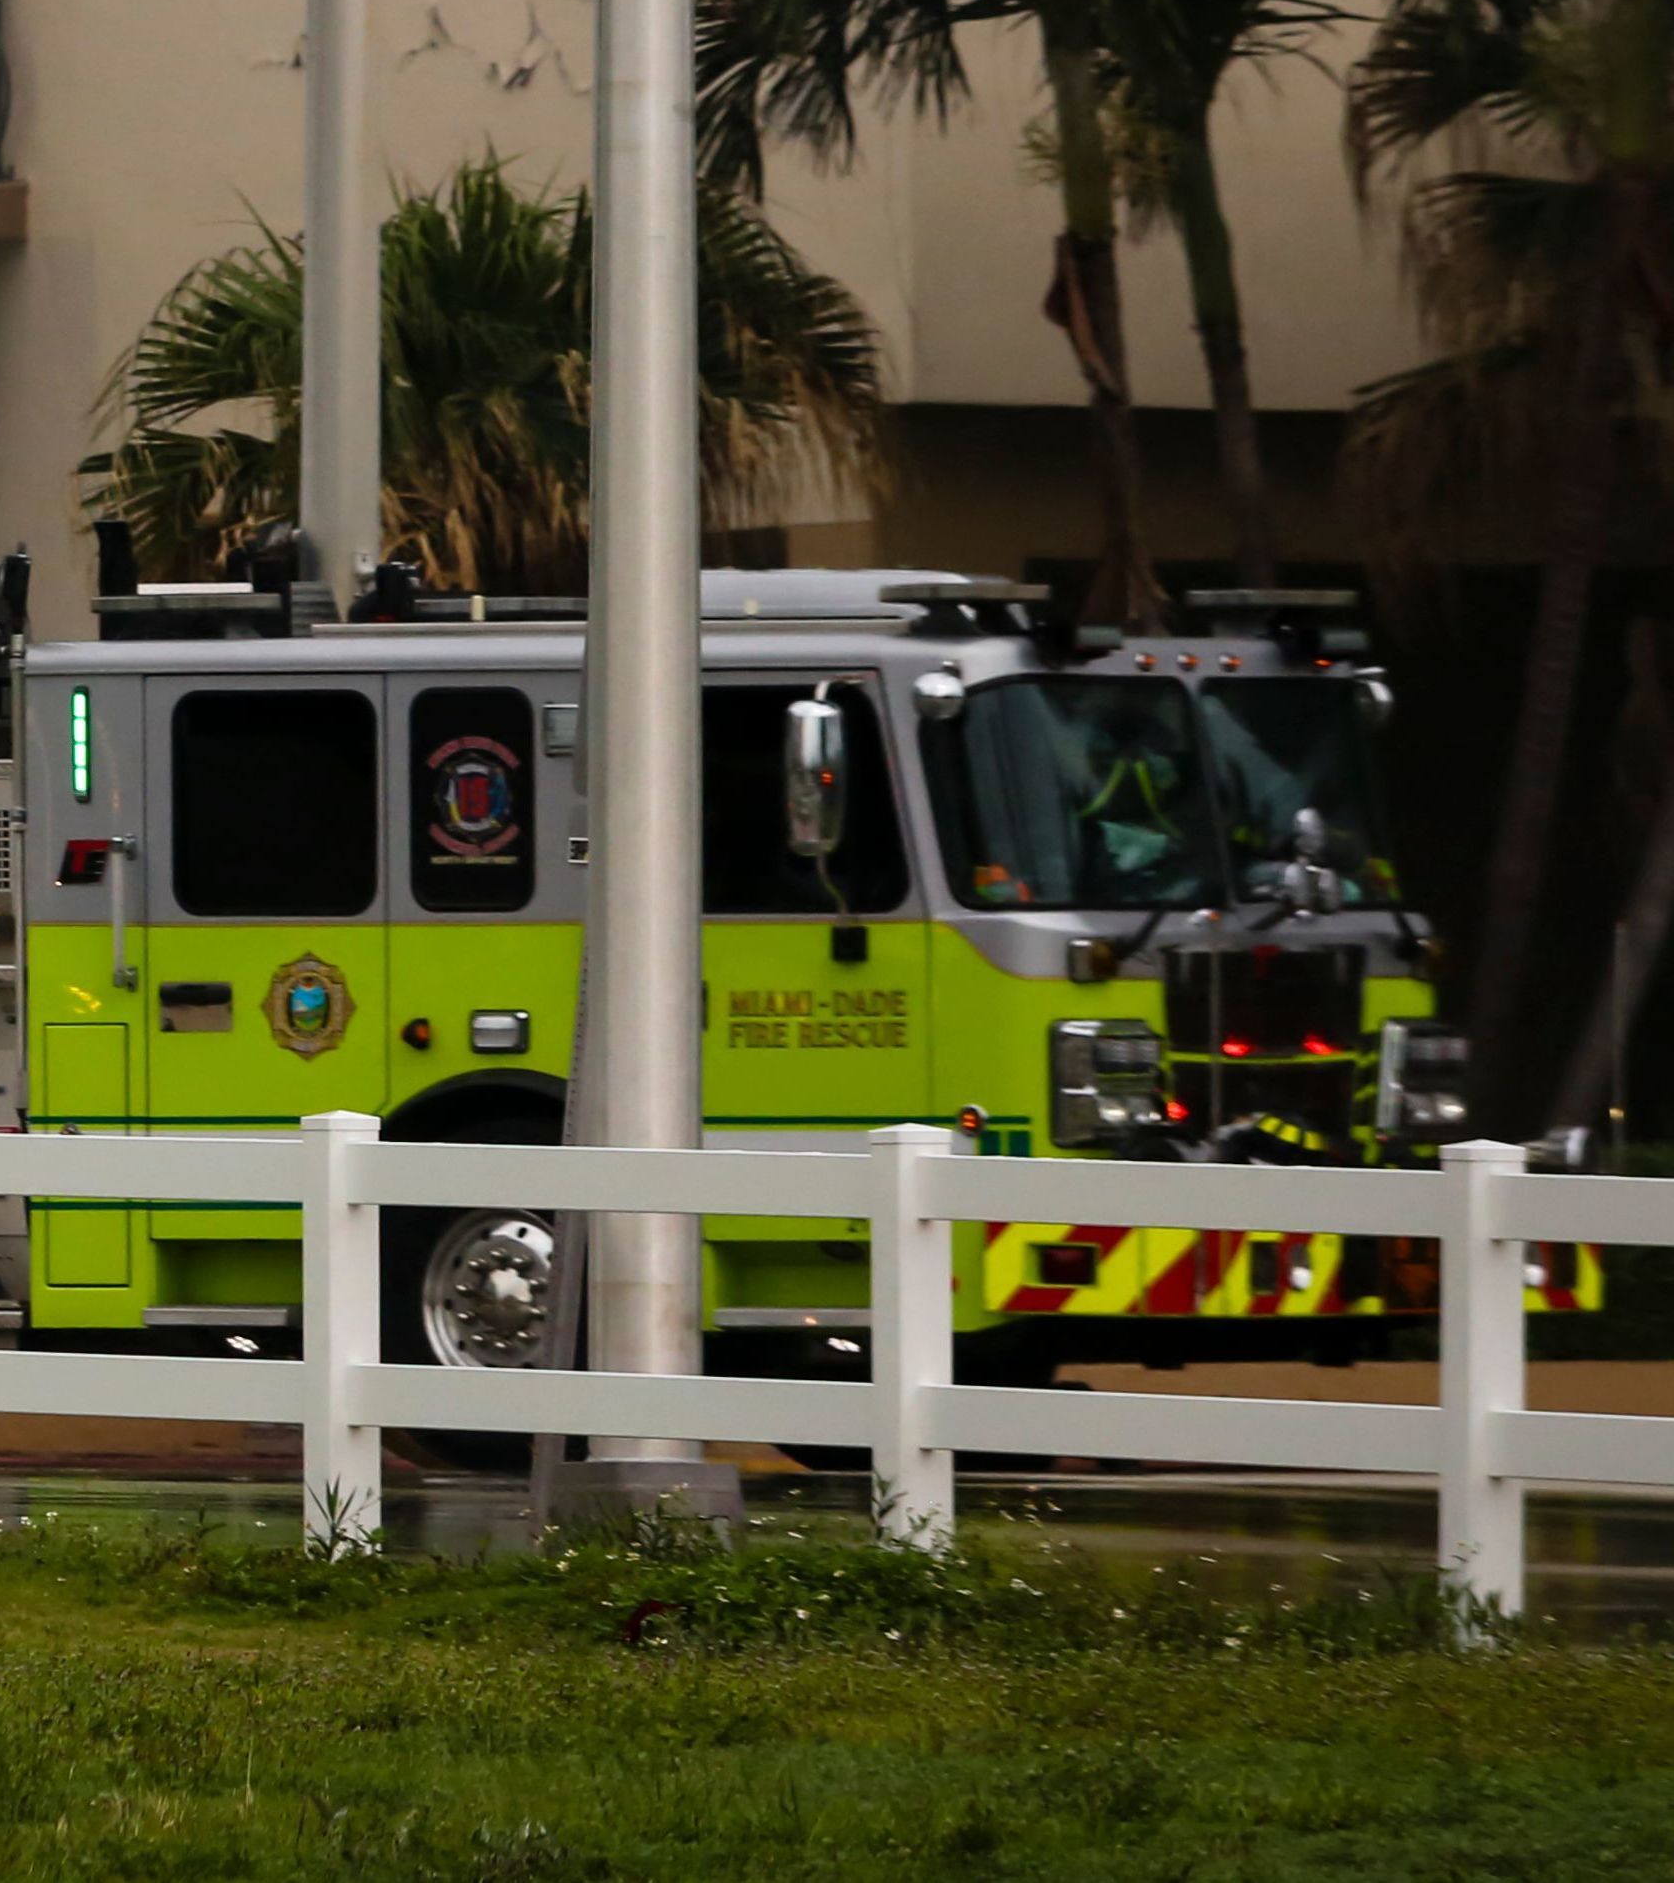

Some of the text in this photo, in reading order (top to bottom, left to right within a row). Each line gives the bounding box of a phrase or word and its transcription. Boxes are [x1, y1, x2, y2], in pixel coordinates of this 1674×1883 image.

[728, 989, 908, 1018] MIAMI-DADE
[728, 1021, 908, 1049] FIRE RESCUE
